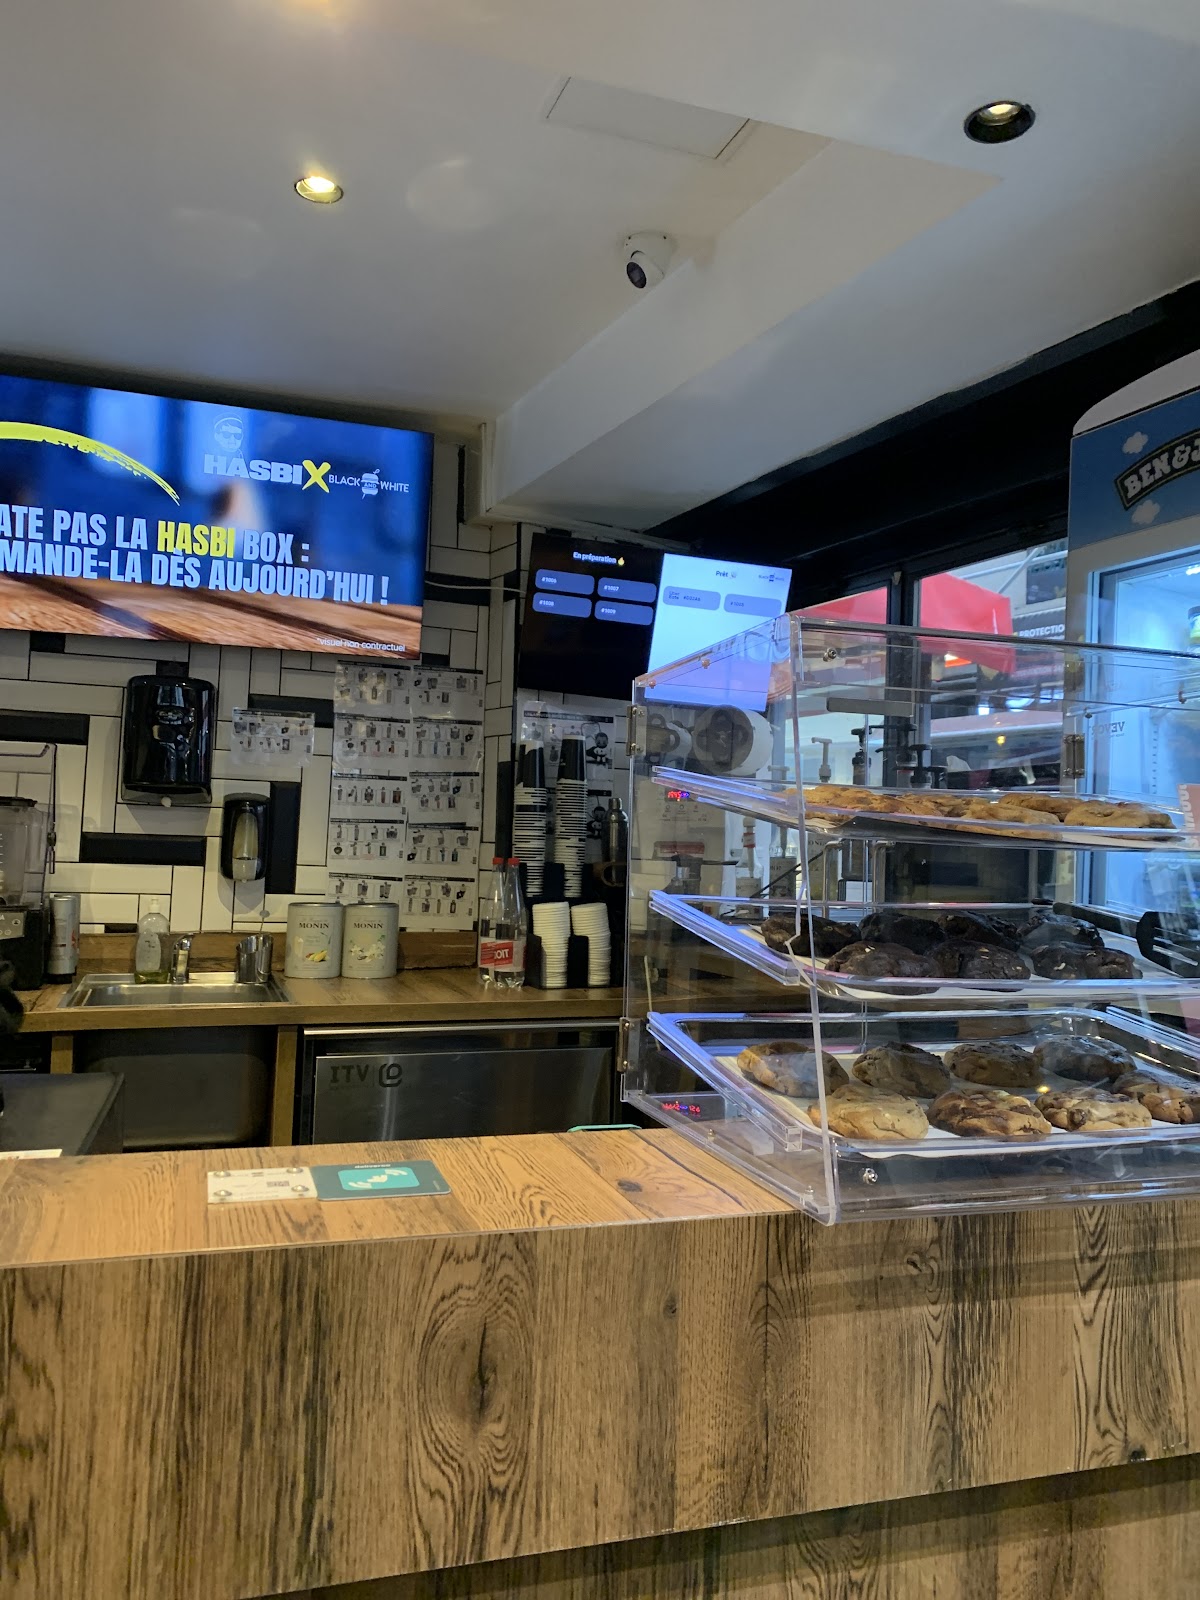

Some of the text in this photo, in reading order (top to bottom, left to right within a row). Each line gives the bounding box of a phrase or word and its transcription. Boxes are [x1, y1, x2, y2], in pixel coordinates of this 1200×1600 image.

[203, 454, 303, 485] HASBI
[328, 474, 360, 487] BLACK
[380, 480, 409, 493] WHITE
[0, 503, 44, 540] ATE
[53, 509, 107, 546] PAS
[116, 515, 148, 551] LA
[156, 520, 236, 558] HASBI
[243, 529, 294, 565] BOX
[572, 551, 617, 564] En préparation
[0, 538, 142, 584] MANDE-LA
[151, 547, 201, 589] DÈS
[208, 559, 375, 604] AUJOURD'HUI
[715, 570, 729, 578] Prêt
[344, 640, 360, 648] non
[361, 642, 406, 652] contractuel
[330, 1064, 370, 1083] ITV
